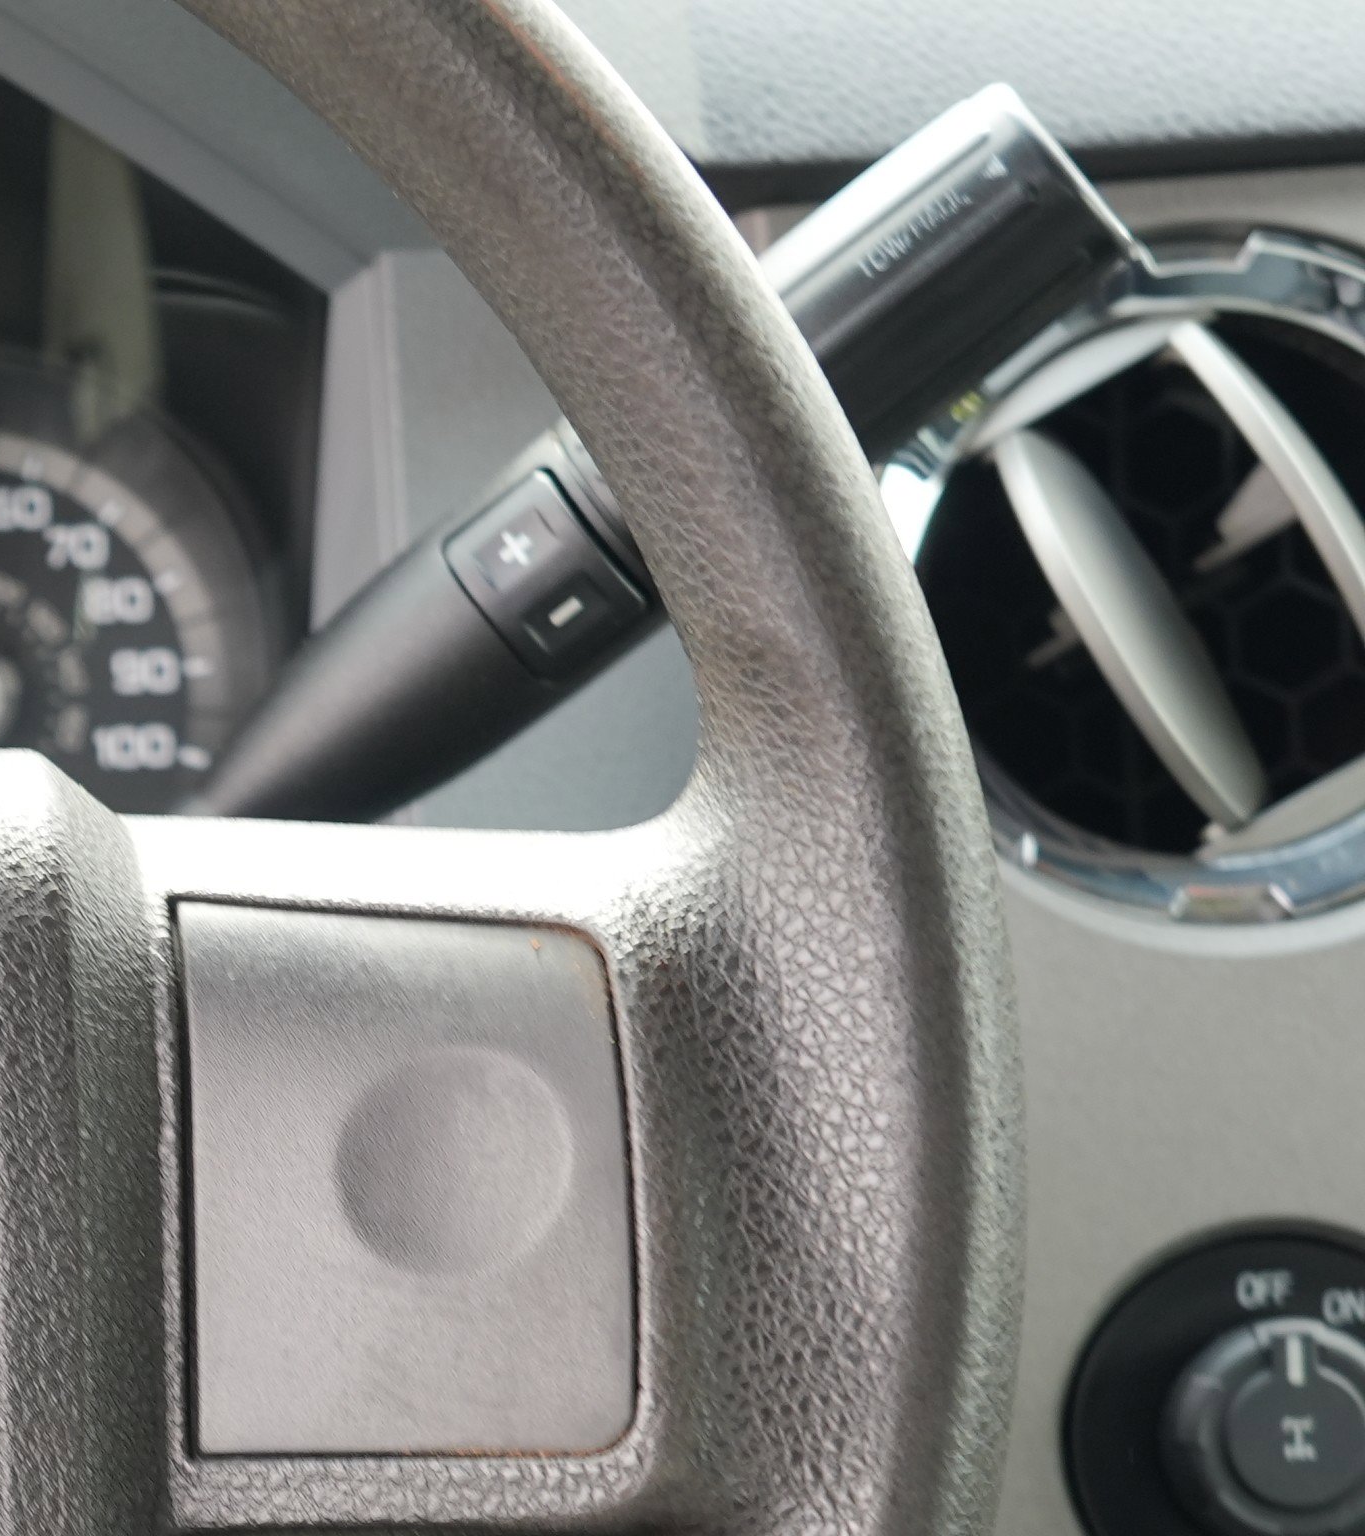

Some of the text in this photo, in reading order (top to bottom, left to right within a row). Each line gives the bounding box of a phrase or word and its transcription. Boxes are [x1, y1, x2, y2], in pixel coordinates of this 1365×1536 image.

[42, 522, 110, 571] 70
[92, 723, 175, 771] 100
[1235, 1270, 1292, 1310] OFF
